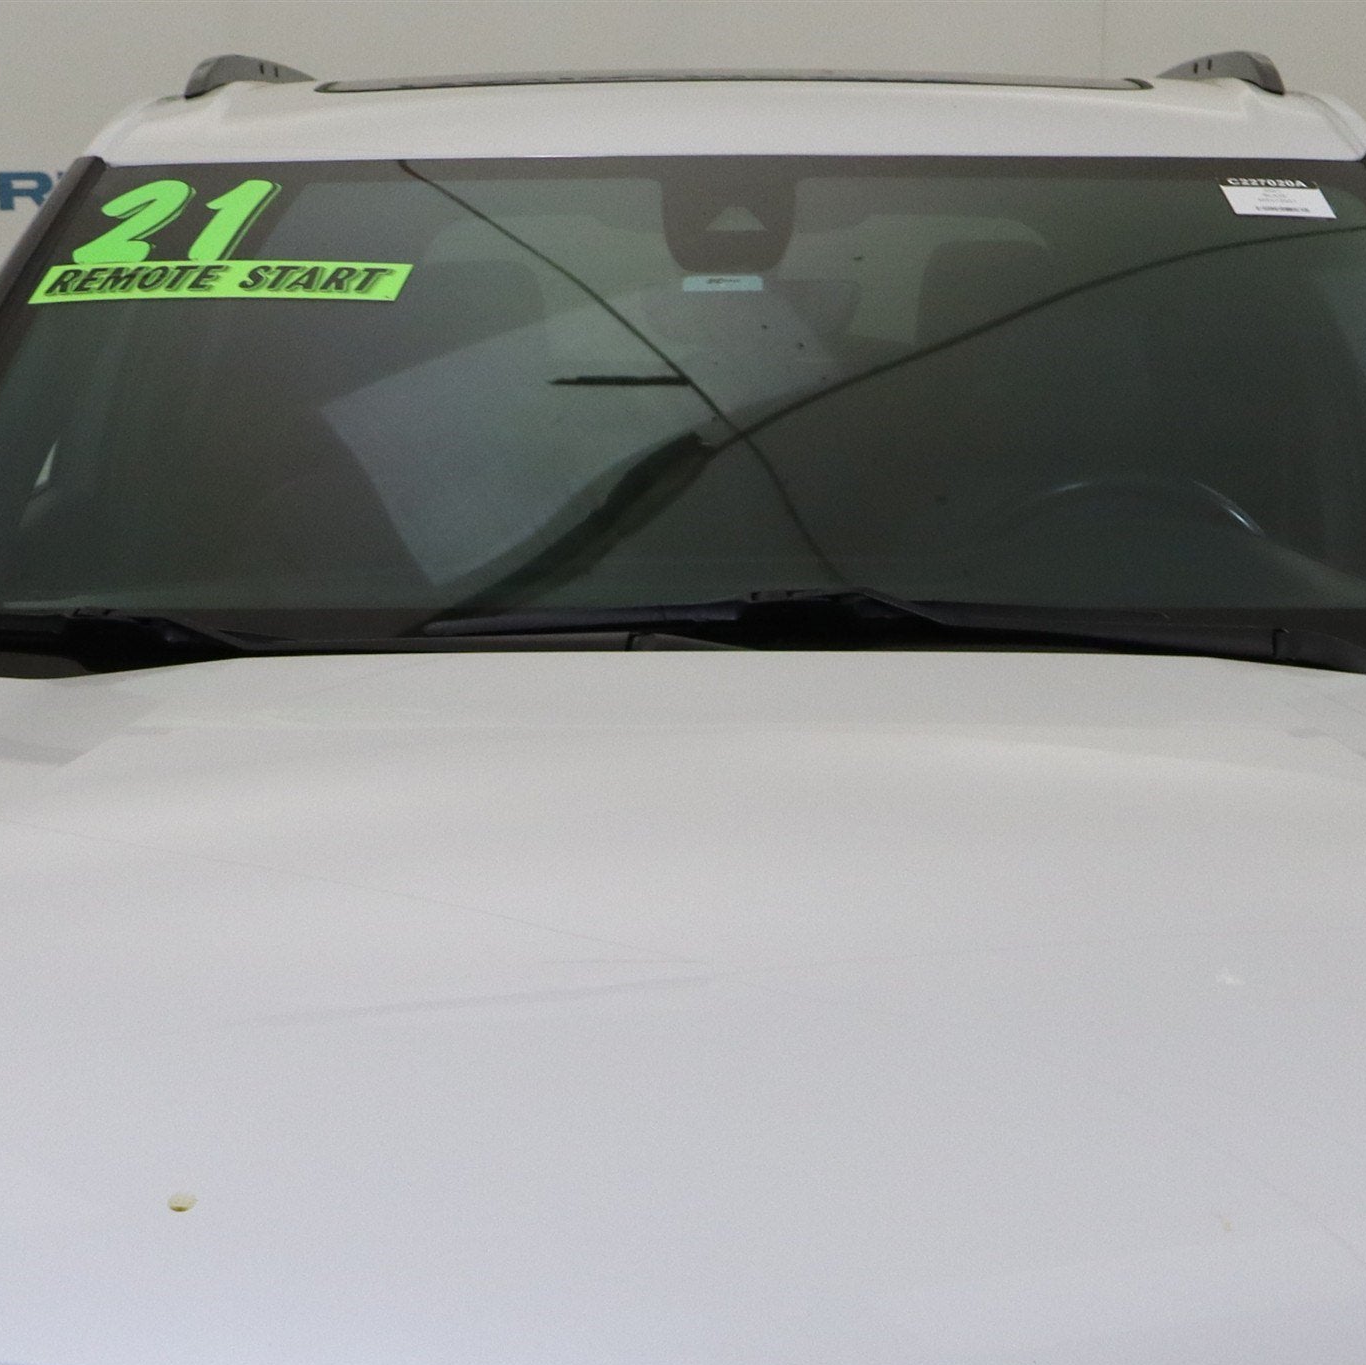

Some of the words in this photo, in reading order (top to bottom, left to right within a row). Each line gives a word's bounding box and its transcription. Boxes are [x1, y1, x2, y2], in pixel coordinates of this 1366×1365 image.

[72, 179, 281, 264] 21
[44, 264, 231, 295] REMOTE
[238, 264, 399, 294] START
